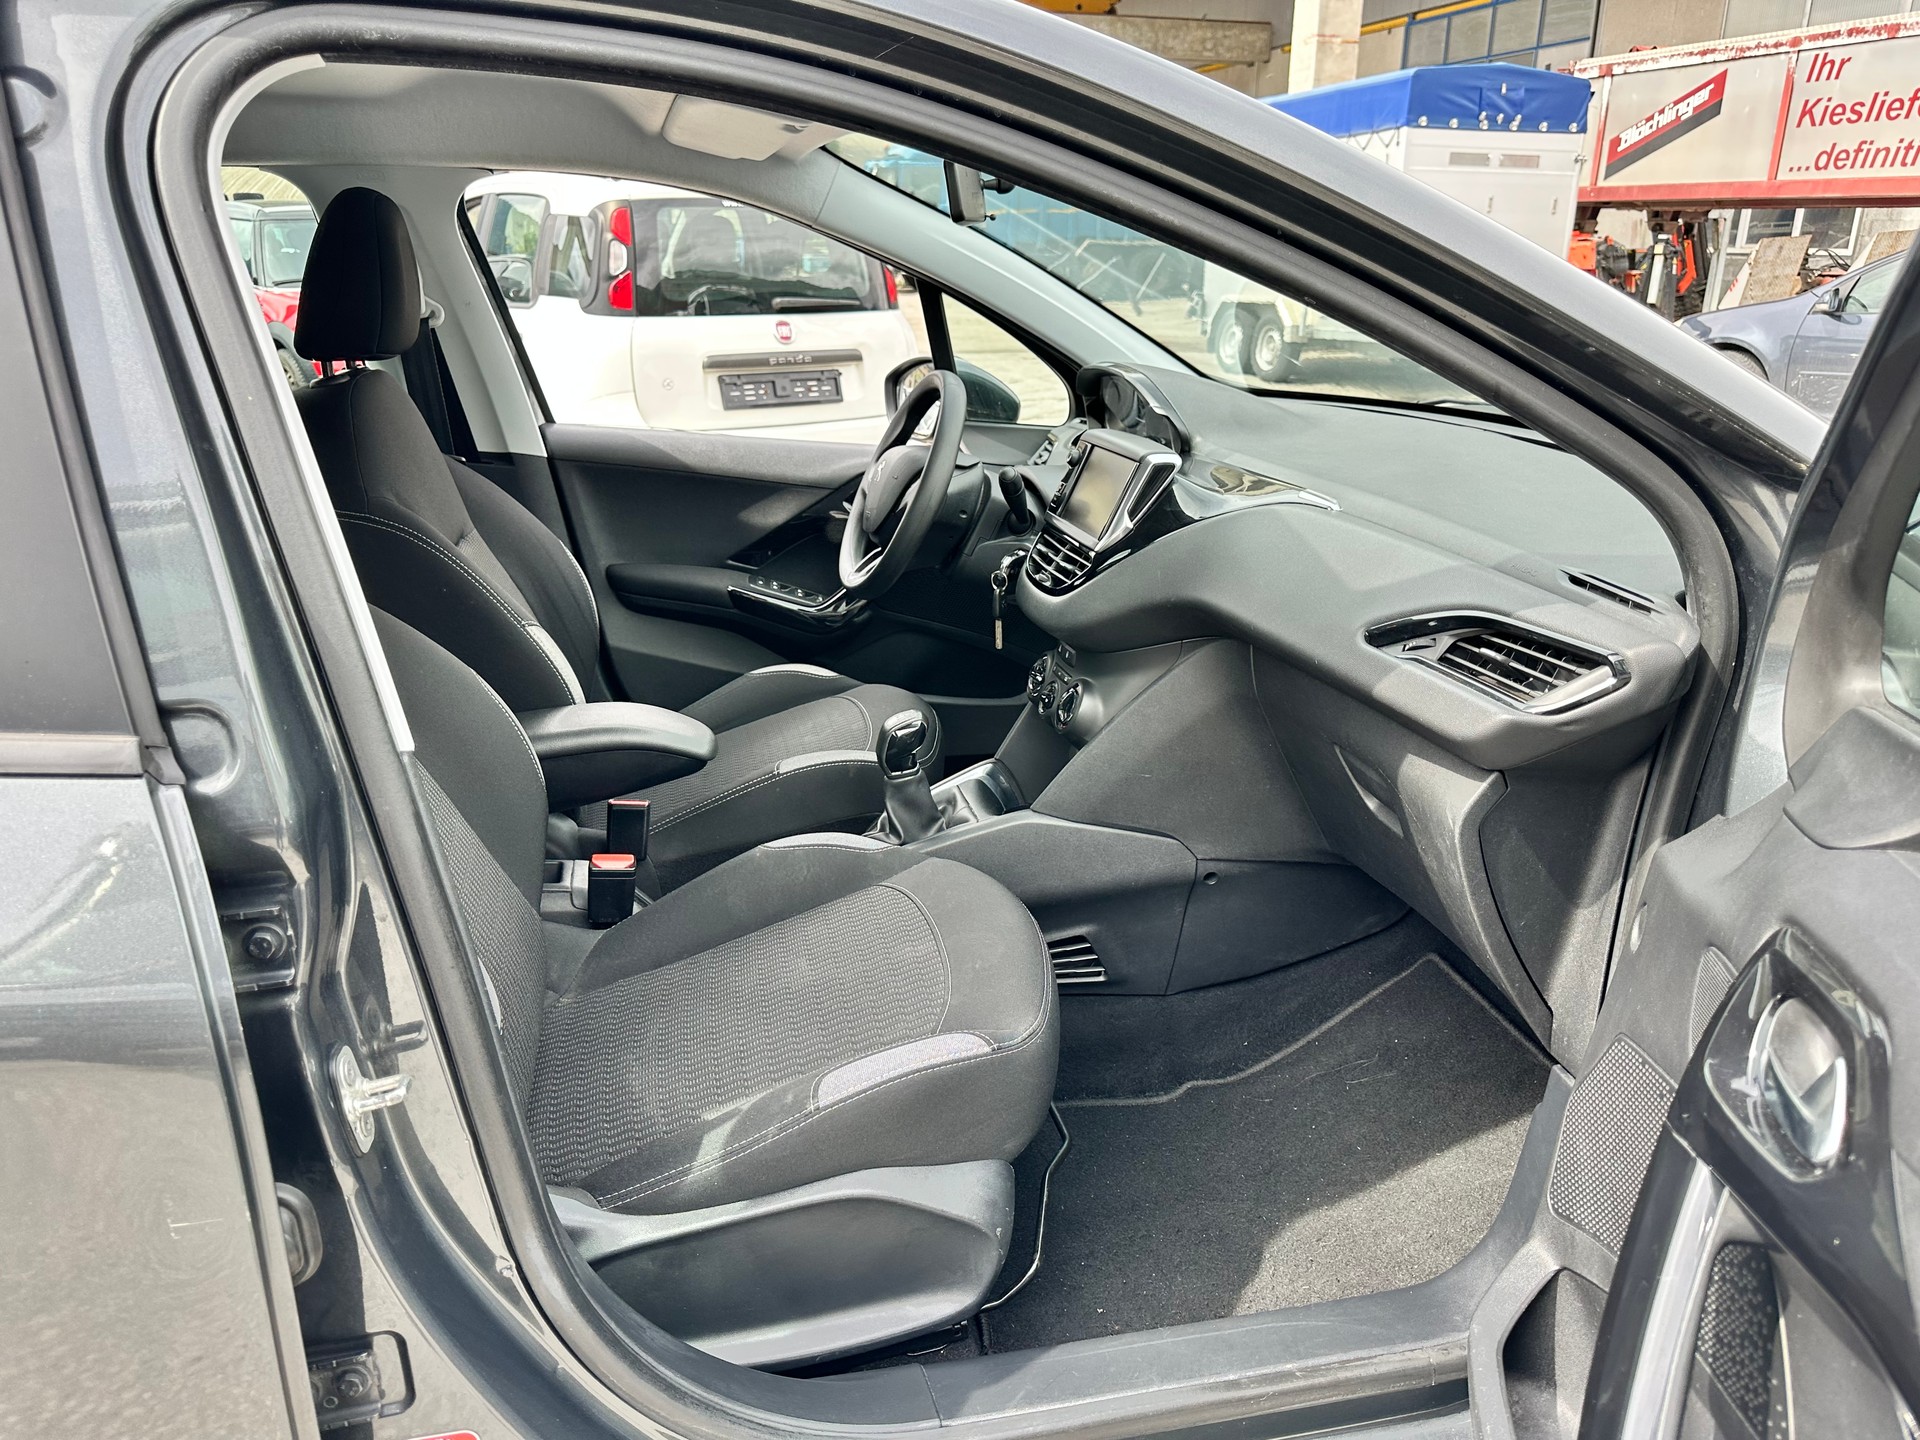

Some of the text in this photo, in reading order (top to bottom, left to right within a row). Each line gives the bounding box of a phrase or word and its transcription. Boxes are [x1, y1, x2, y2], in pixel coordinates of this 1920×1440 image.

[1805, 52, 1852, 83] Ihr
[1617, 83, 1715, 152] Blöchlinger
[1795, 87, 1920, 128] Kieslief
